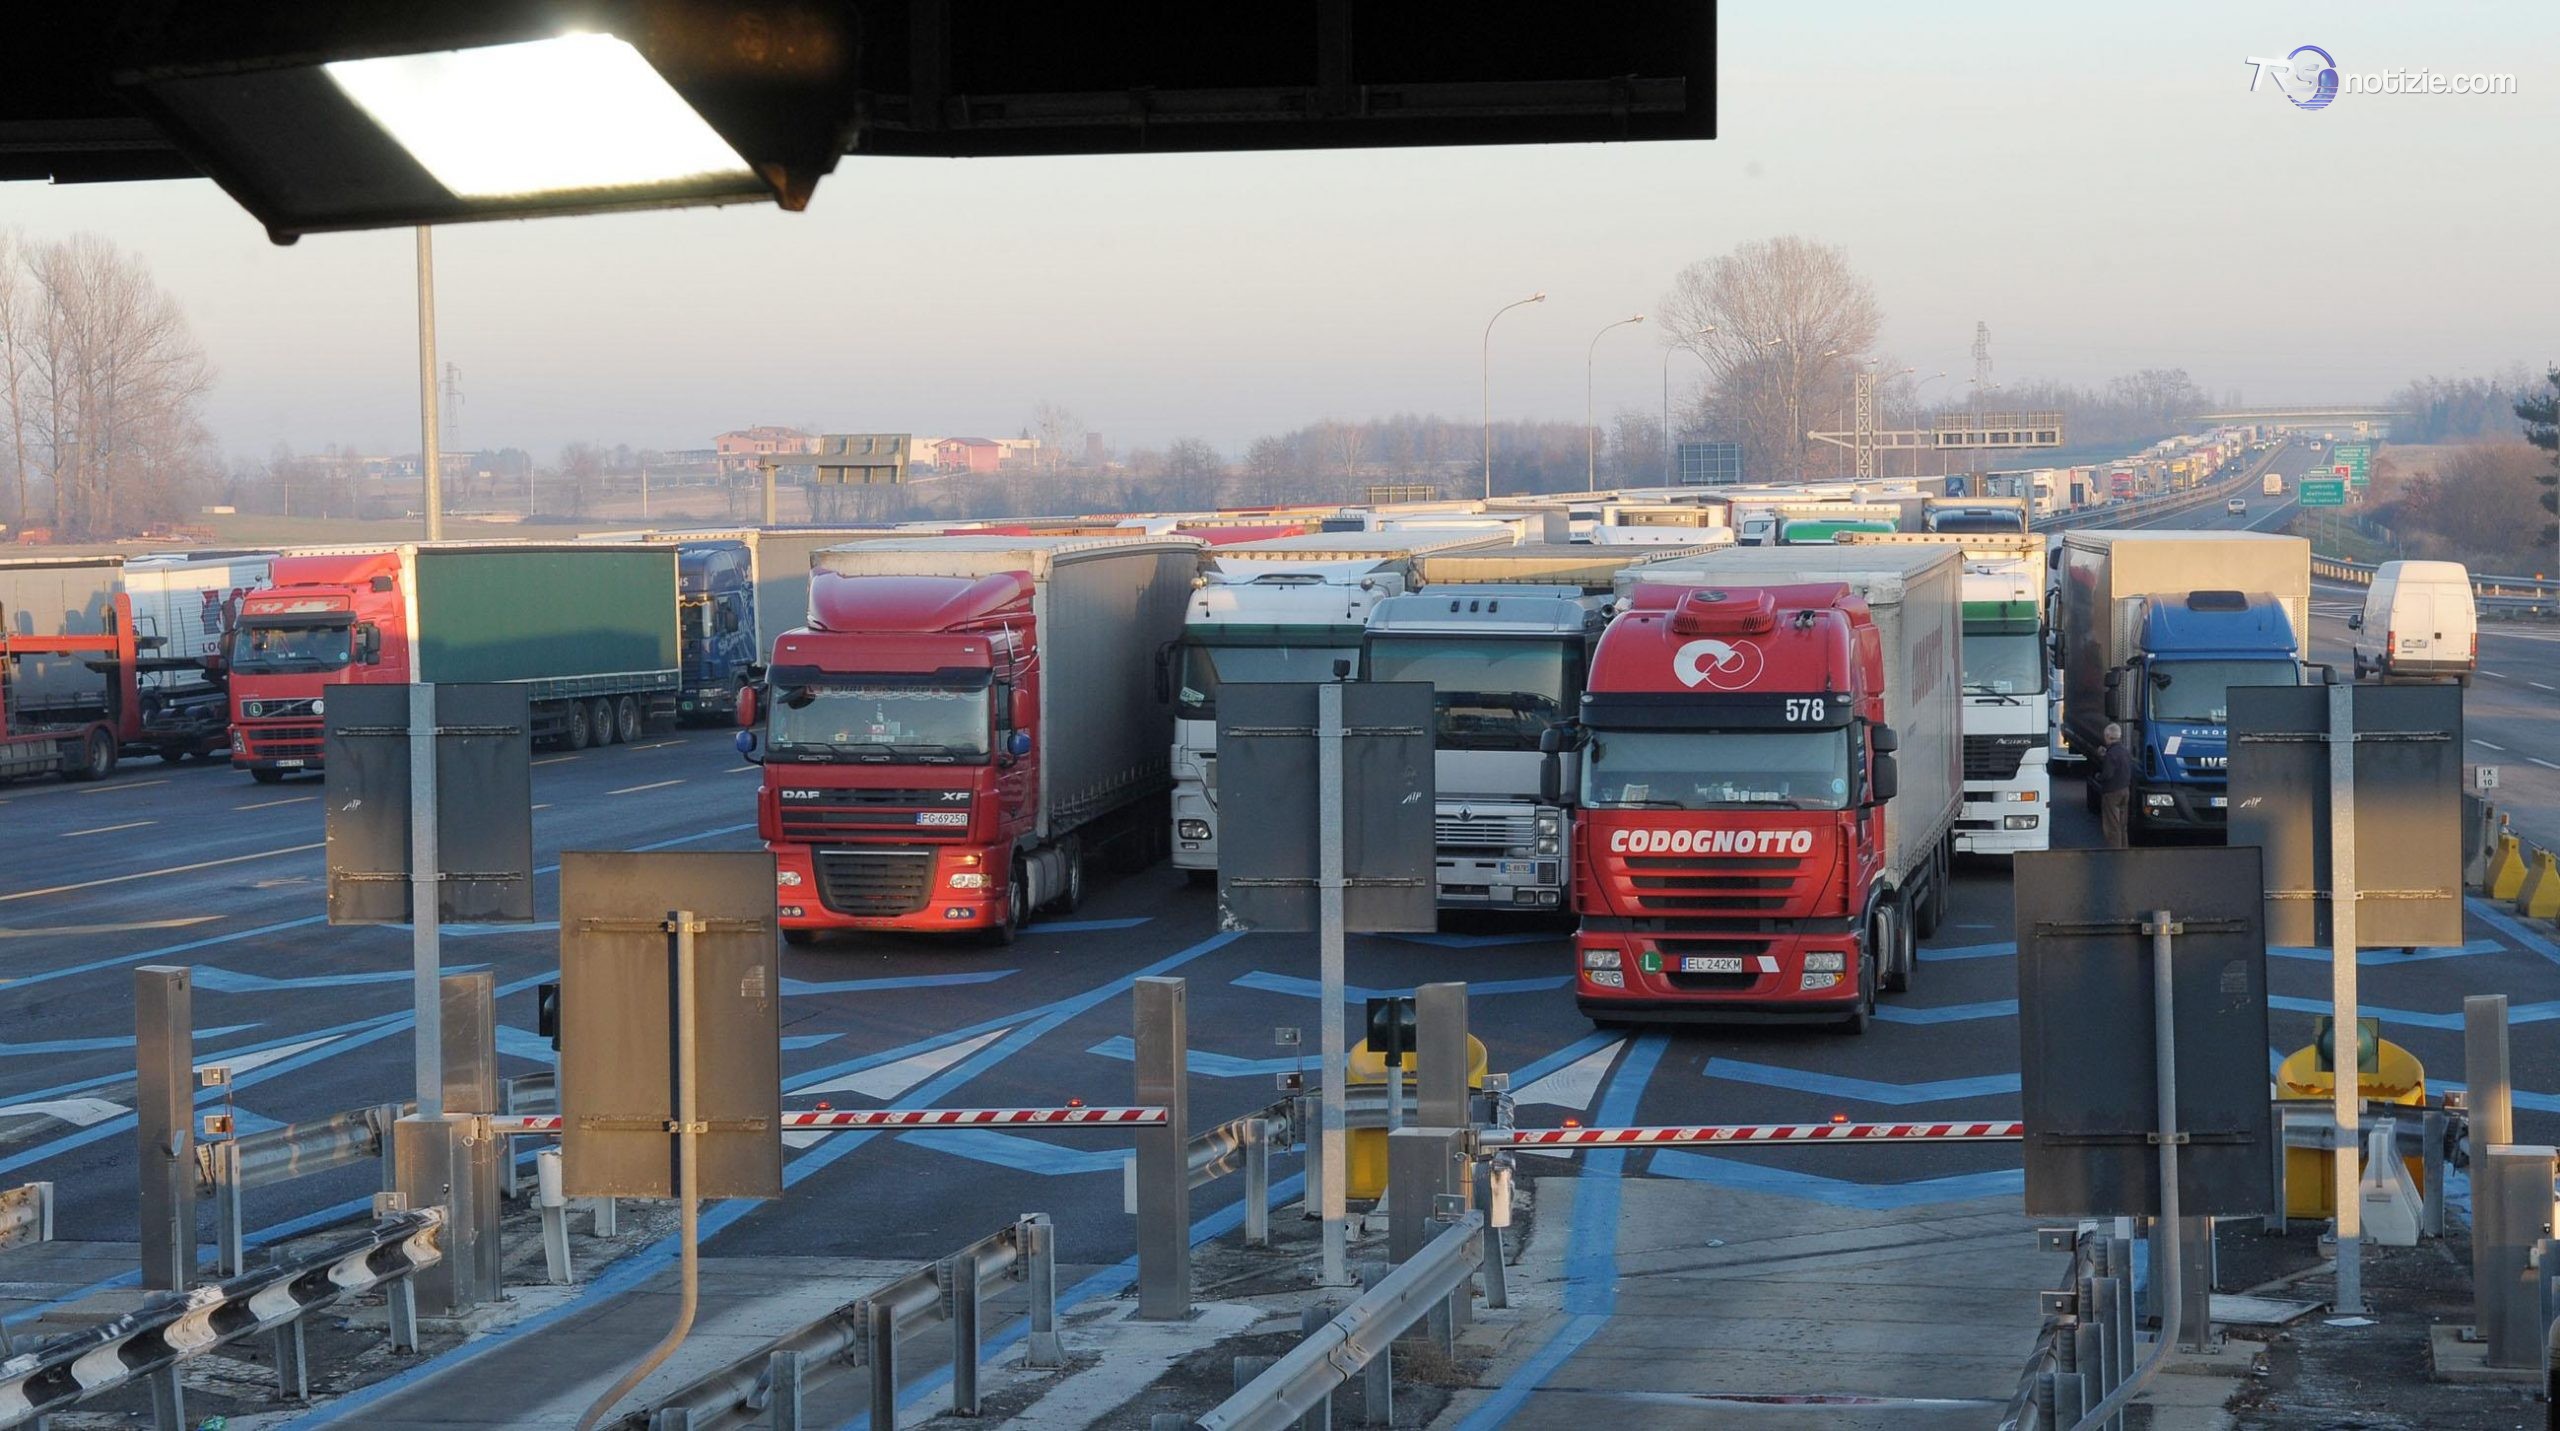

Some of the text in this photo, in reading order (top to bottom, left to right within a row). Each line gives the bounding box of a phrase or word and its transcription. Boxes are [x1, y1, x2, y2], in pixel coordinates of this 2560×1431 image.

[1786, 698, 1825, 722] 578
[782, 790, 820, 799] DAF
[941, 792, 970, 801] XF
[1610, 829, 1813, 853] CODOGNOTTO
[1645, 954, 1657, 971] L
